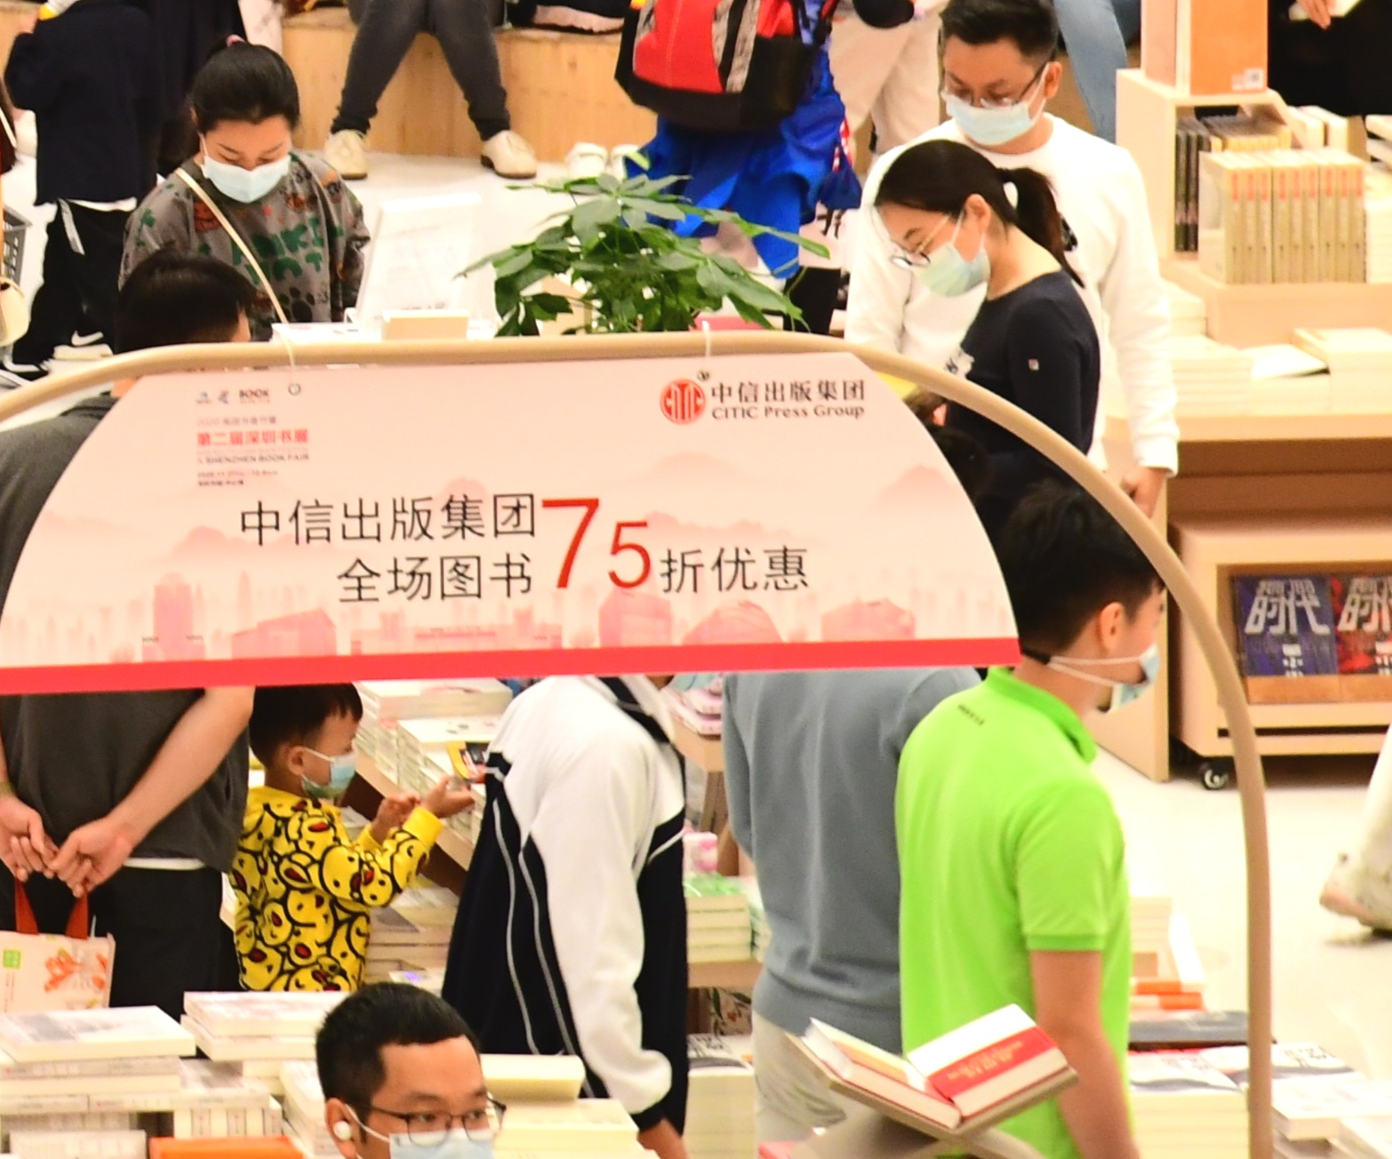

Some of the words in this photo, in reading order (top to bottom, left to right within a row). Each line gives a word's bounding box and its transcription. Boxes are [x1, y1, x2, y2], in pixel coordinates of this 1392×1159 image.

[711, 380, 865, 403] 中信出版集团
[712, 407, 759, 419] CITIC
[765, 406, 808, 418] Press
[814, 404, 865, 420] Group
[240, 493, 536, 546] 中信出版集团
[337, 552, 533, 604] 全场图书
[659, 545, 809, 594] 折优惠
